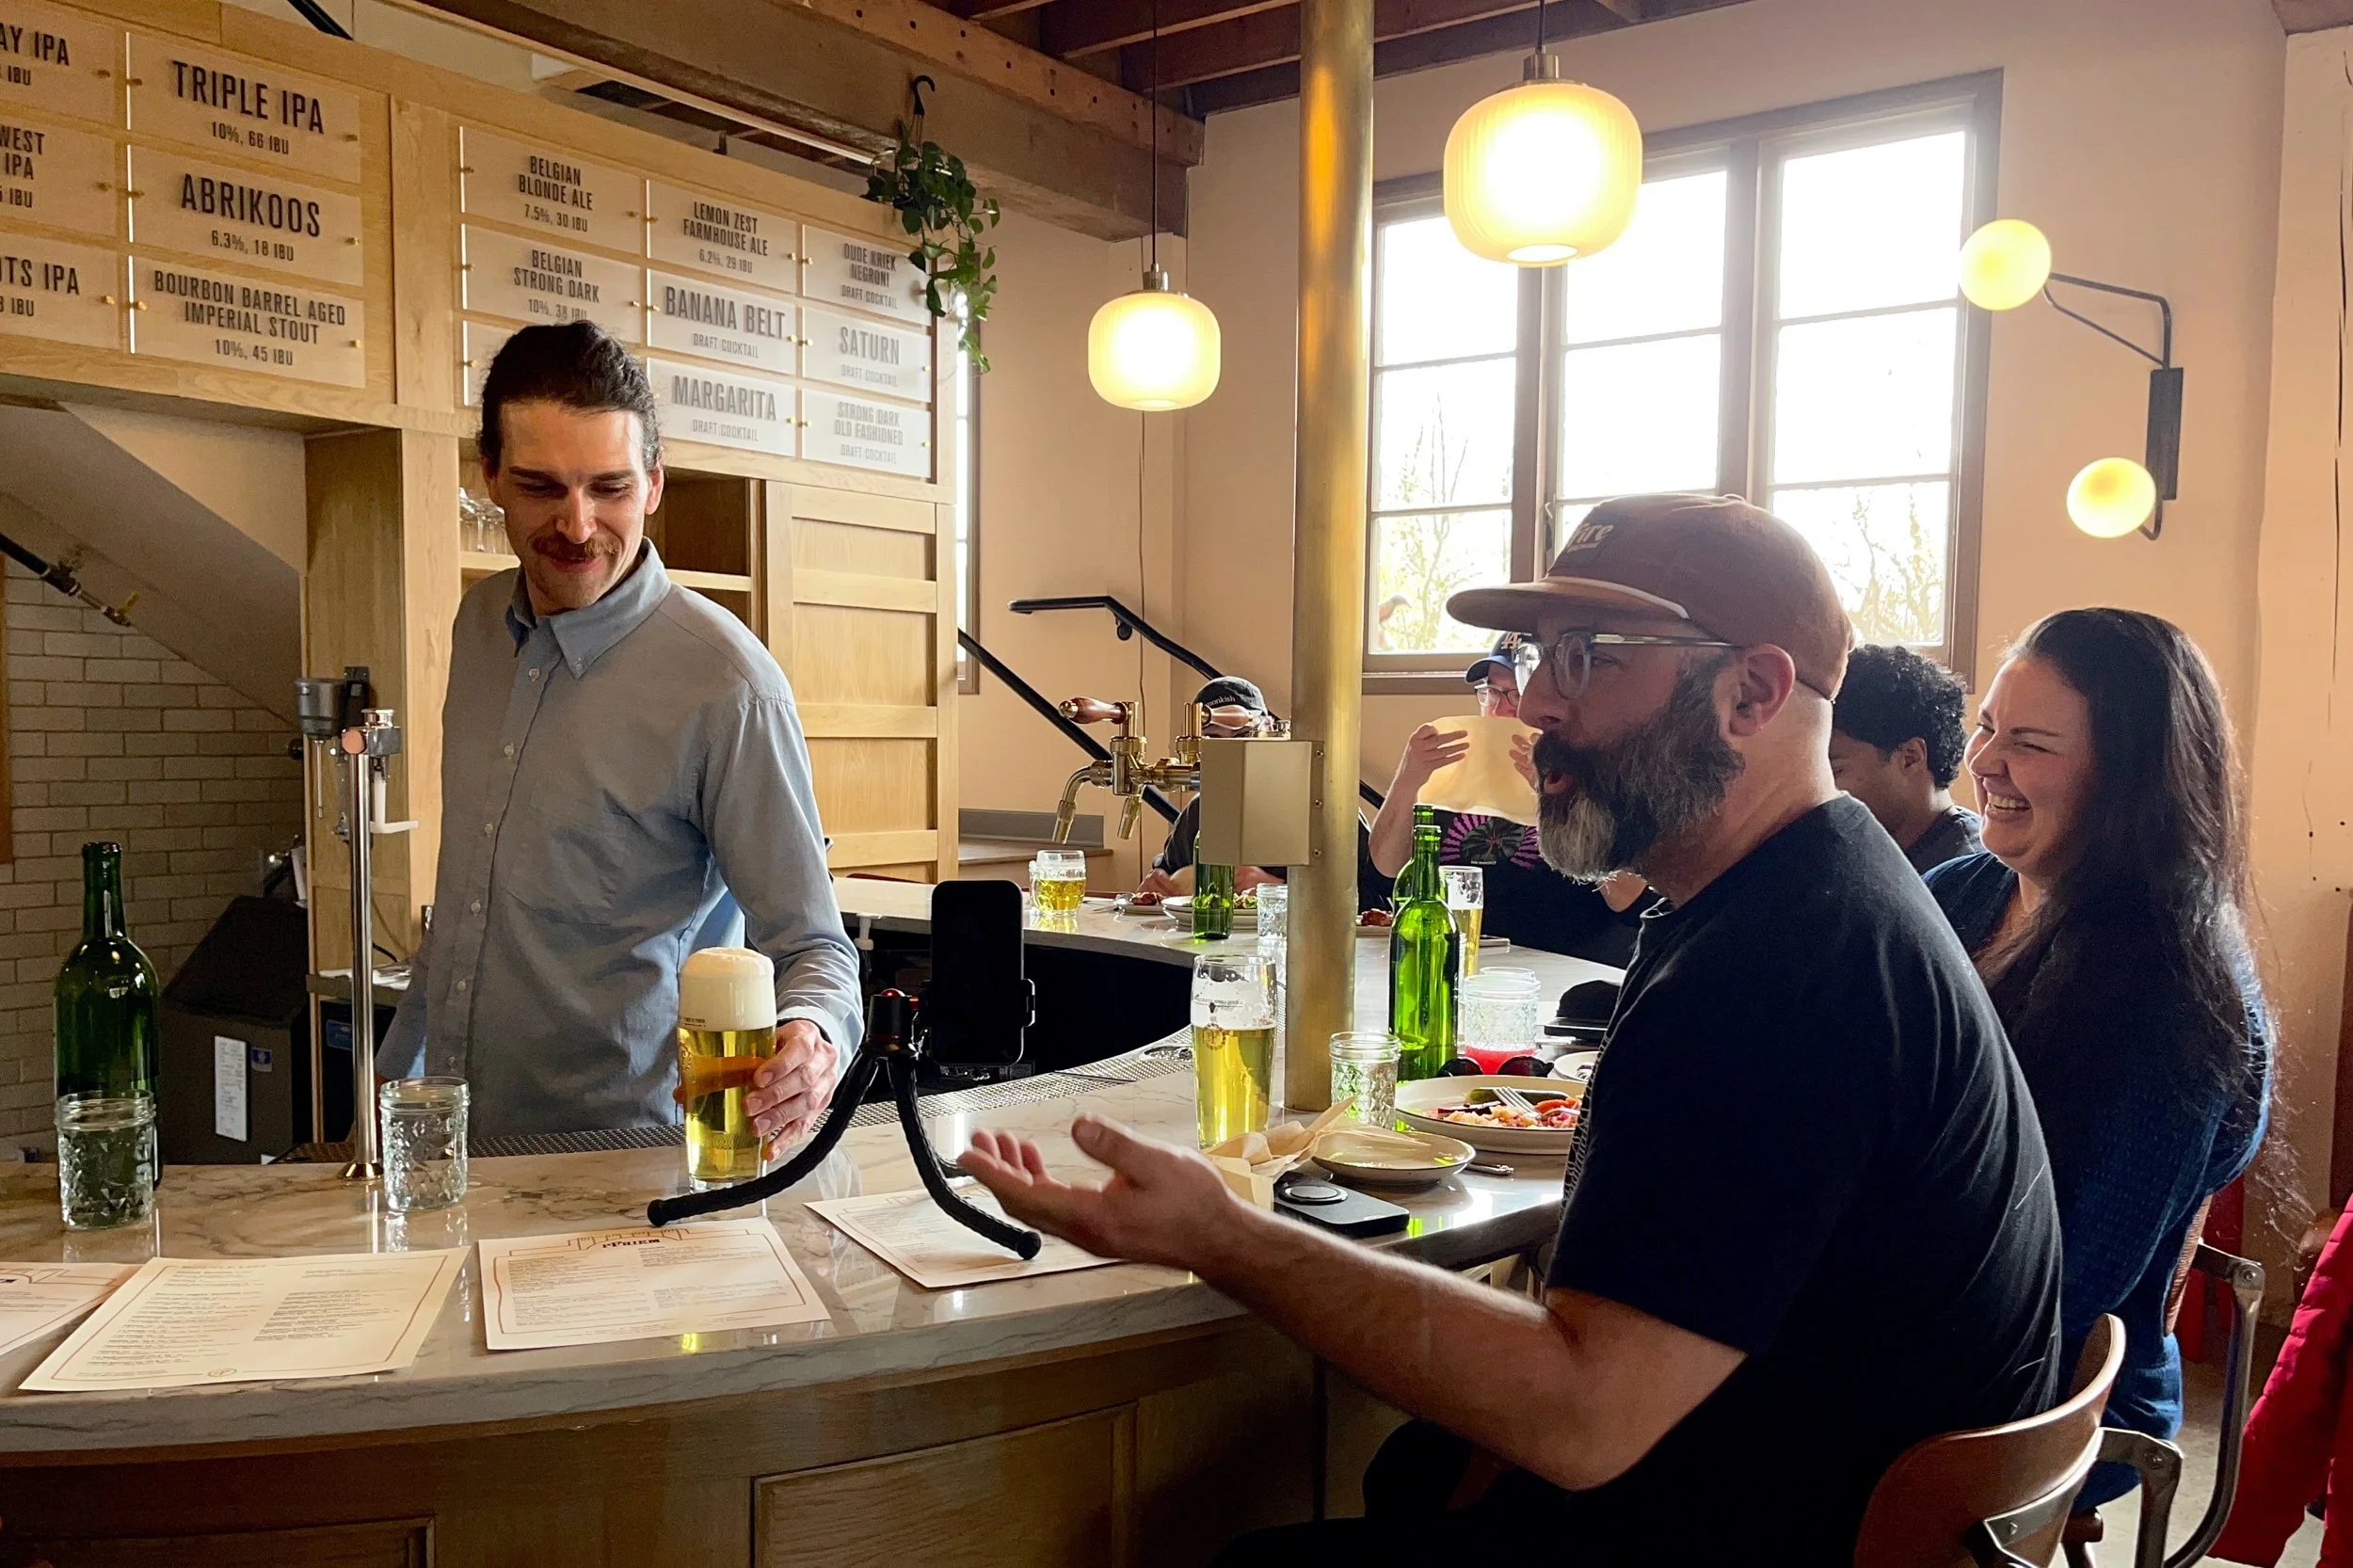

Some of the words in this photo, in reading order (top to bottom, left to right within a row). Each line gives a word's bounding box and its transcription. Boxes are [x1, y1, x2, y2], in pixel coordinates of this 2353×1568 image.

[34, 31, 70, 67] IPA
[8, 65, 31, 86] IBU
[172, 60, 268, 120] TRIPLE
[282, 90, 324, 135] IPA
[212, 121, 244, 144] 10%,
[248, 130, 264, 149] 66
[269, 136, 289, 155] IBU
[5, 152, 34, 180] IPA
[529, 155, 582, 186] BELGIAN
[9, 187, 32, 208] IBU
[181, 173, 321, 237] ABRIKOOS
[519, 174, 568, 205] BLONDE
[571, 188, 594, 211] ALE
[556, 212, 568, 228] 30
[571, 216, 588, 233] IBU
[694, 201, 729, 227] LEMON
[734, 213, 758, 234] ZEST
[212, 230, 248, 254] 6.3%,
[255, 240, 269, 256] 18
[274, 243, 294, 262] IBU
[683, 218, 746, 251] FARMHOUSE
[750, 236, 768, 257] ALE
[532, 248, 583, 279] BELGIAN
[739, 259, 753, 274] IBU
[843, 243, 868, 264] OUDE
[870, 250, 897, 272] KRIEK
[0, 254, 32, 287] TS
[44, 263, 79, 296] IPA
[514, 266, 563, 296] STRONG
[568, 280, 600, 304] DARK
[850, 263, 890, 288] NEGRONI
[11, 297, 34, 317] IBU
[154, 270, 234, 305] BOURBON
[242, 287, 301, 317] BARREL
[308, 300, 346, 326] AGED
[840, 284, 863, 300] DRAFT
[865, 291, 899, 310] COCKTAIL
[184, 301, 262, 335] IMPERIAL
[268, 316, 319, 344] STOUT
[664, 285, 738, 330] BANANA
[745, 304, 786, 341] BELT
[215, 339, 248, 360] 10%,
[252, 345, 268, 362] 45
[273, 348, 294, 366] IBU
[693, 332, 718, 350] DRAFT
[721, 339, 760, 359] COCKTAIL
[840, 326, 900, 366] SATURN
[841, 363, 863, 380] DRAFT
[865, 368, 898, 388] COCKTAIL
[673, 375, 777, 423] MARGARITA
[837, 401, 874, 424] STRONG
[876, 408, 901, 428] DARK
[692, 418, 717, 437] DRAFT
[720, 424, 759, 442] COCKTAIL
[834, 419, 853, 438] OLD
[855, 423, 904, 446] FASHIONED
[840, 443, 862, 459] DRAFT
